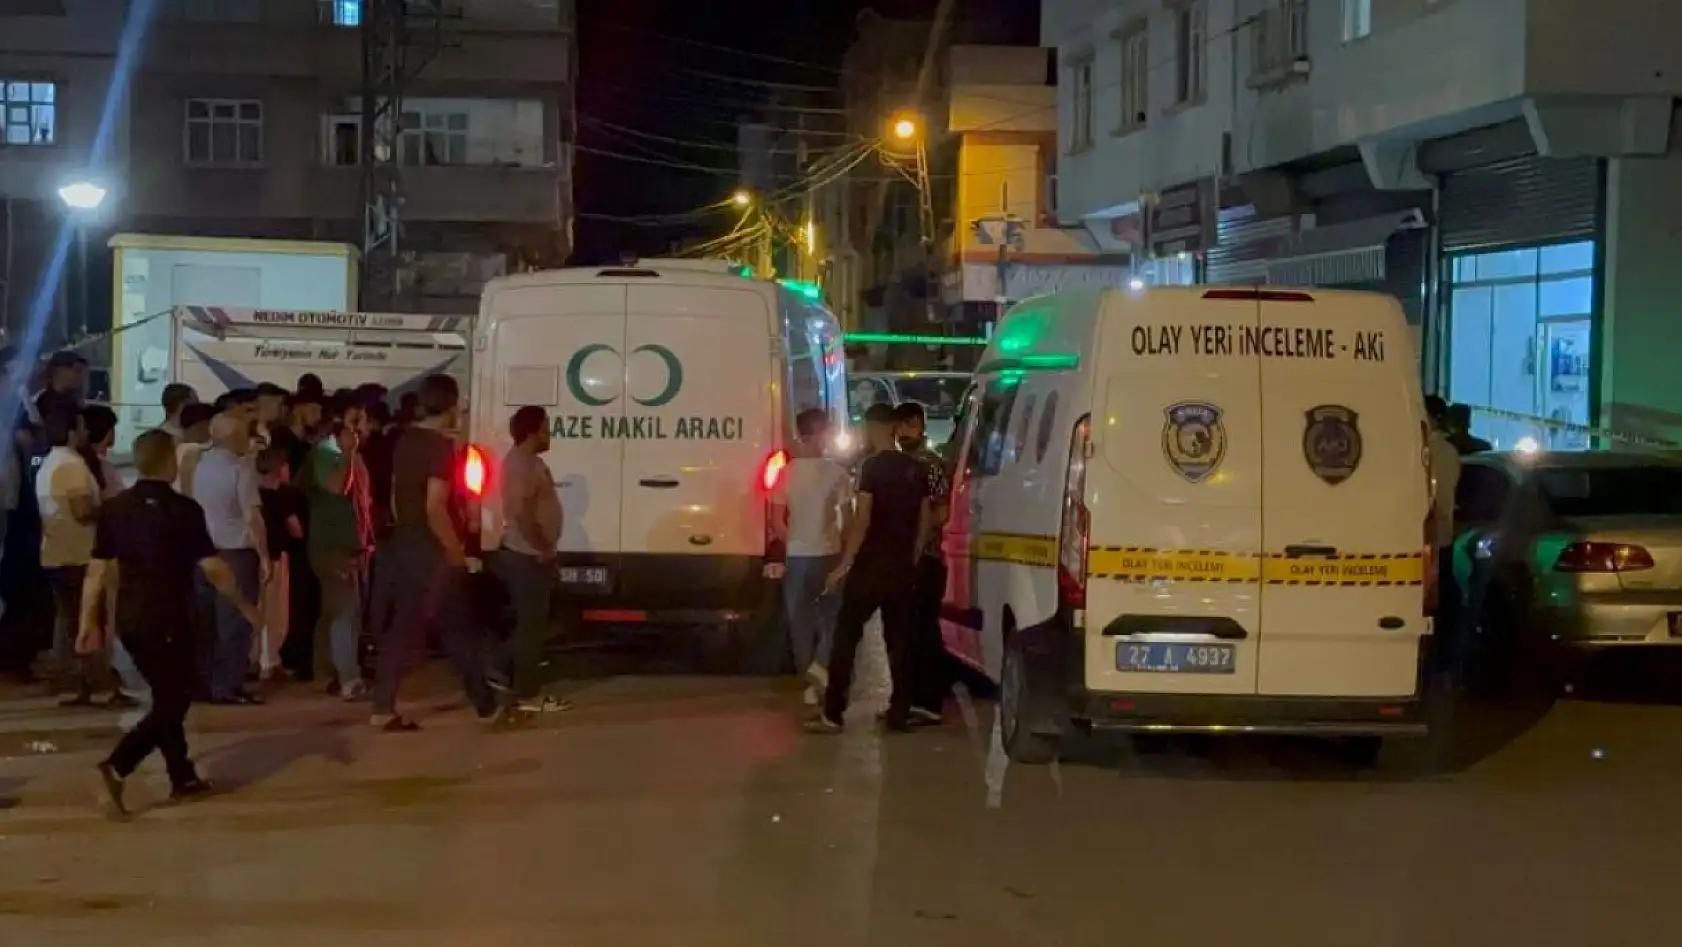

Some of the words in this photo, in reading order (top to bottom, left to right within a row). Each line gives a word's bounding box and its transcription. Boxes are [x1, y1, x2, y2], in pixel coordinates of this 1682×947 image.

[1131, 325, 1182, 356] OLAY
[674, 416, 744, 440] ARACI
[1129, 645, 1151, 665] 27
